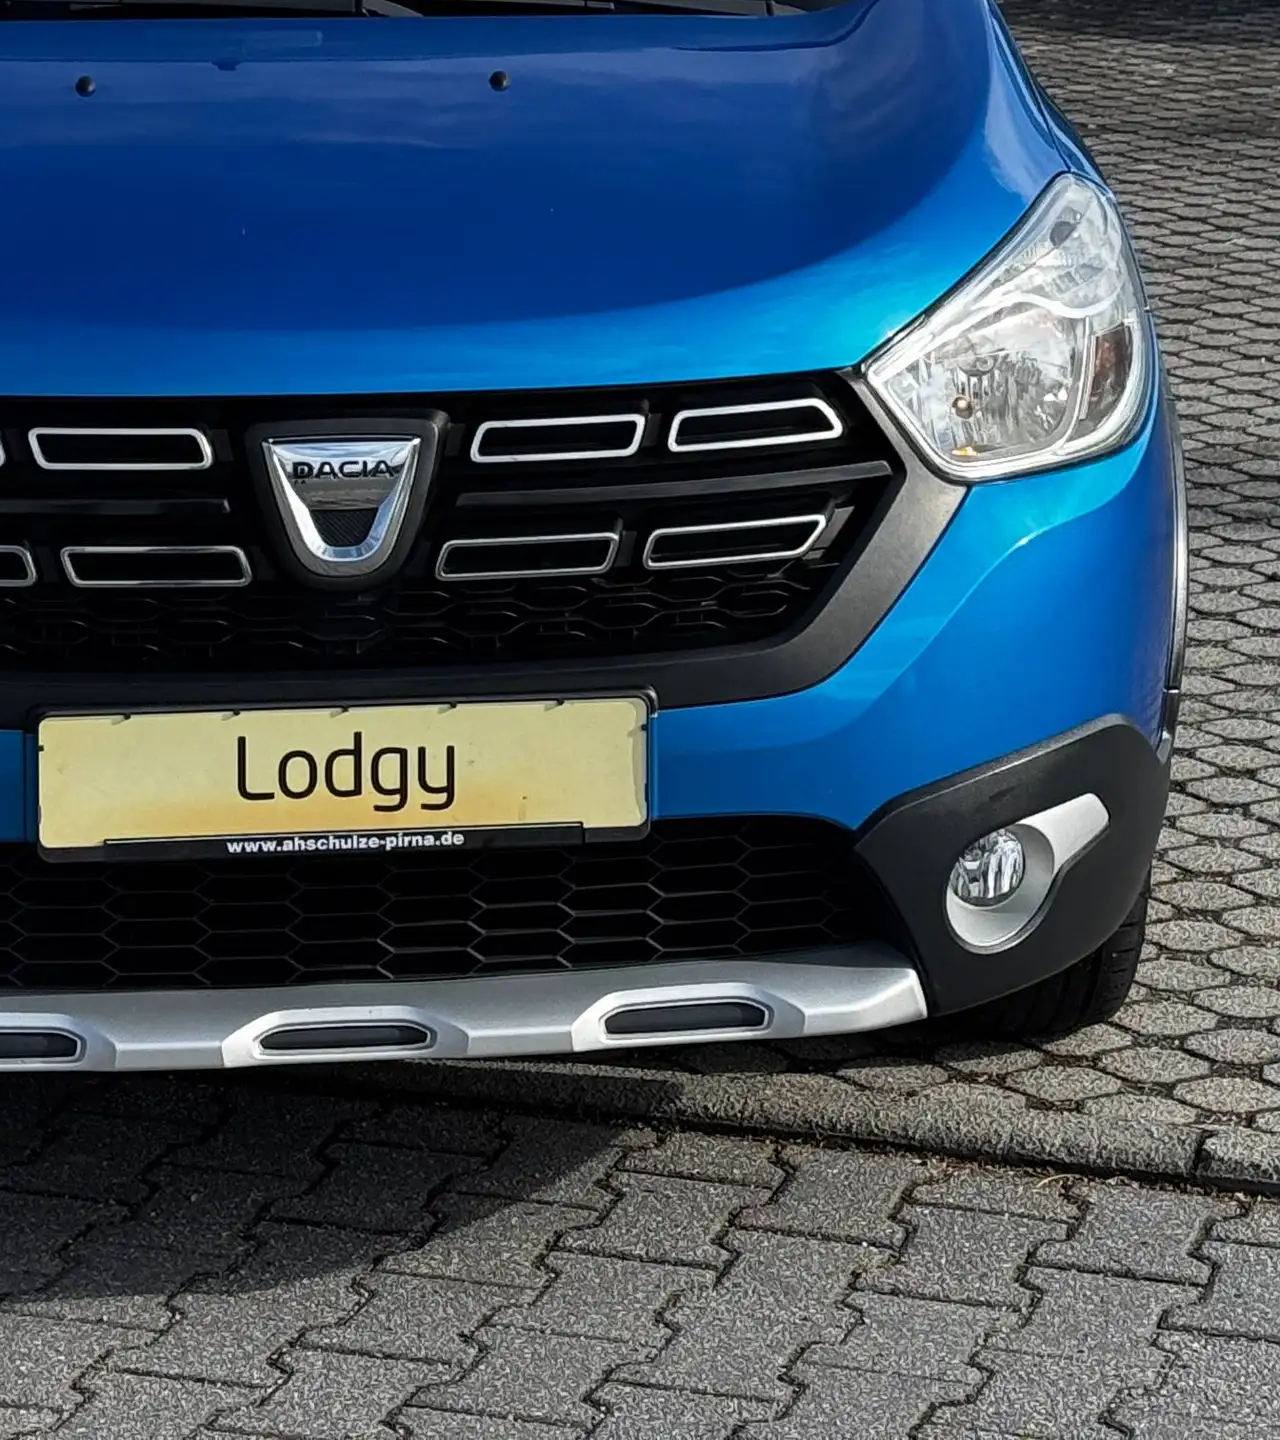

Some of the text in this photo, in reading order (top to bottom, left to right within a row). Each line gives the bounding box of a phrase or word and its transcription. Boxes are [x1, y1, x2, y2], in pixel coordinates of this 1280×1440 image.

[292, 460, 394, 479] DACIA
[236, 730, 456, 813] Lodgy
[226, 830, 465, 854] www.ahschulze-pirna.de
